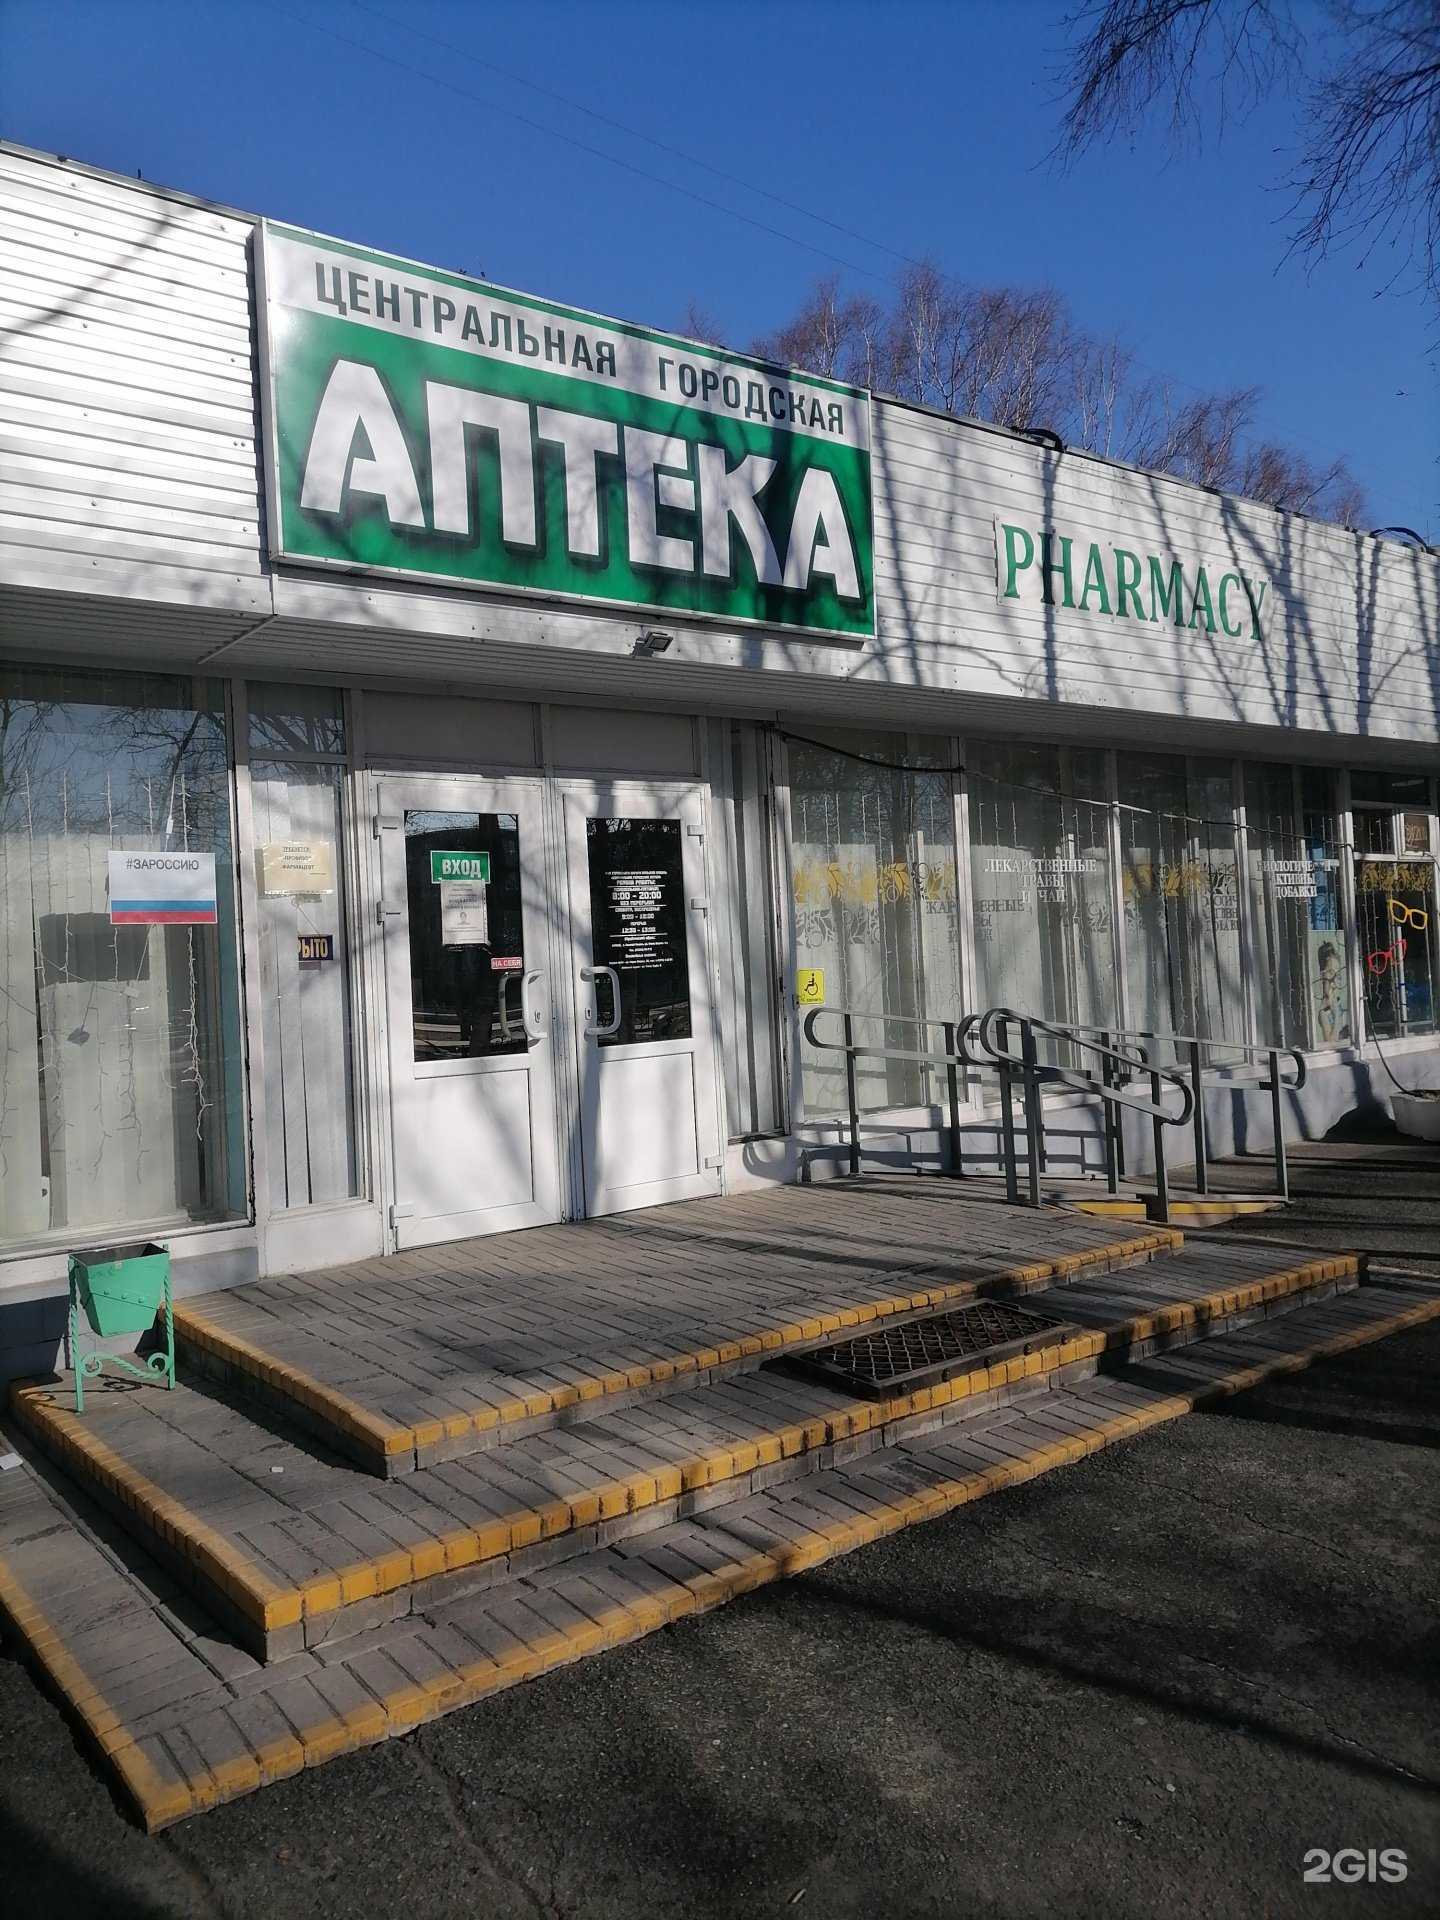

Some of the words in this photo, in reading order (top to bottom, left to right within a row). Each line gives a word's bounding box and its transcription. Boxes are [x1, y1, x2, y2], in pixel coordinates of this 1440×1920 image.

[315, 261, 617, 378] ЦЕНТРАЛЬНАЯ
[658, 356, 844, 435] ГОРОДСКАЯ
[300, 359, 861, 599] АПТЕКА
[1001, 523, 1268, 641] PHARMACY
[126, 858, 200, 871] #ЗАРОССИЮ
[441, 858, 482, 879] ВХОД
[984, 858, 1097, 873] ЛЕКАРСТВЕННЫЕ
[638, 891, 662, 900] 20:00
